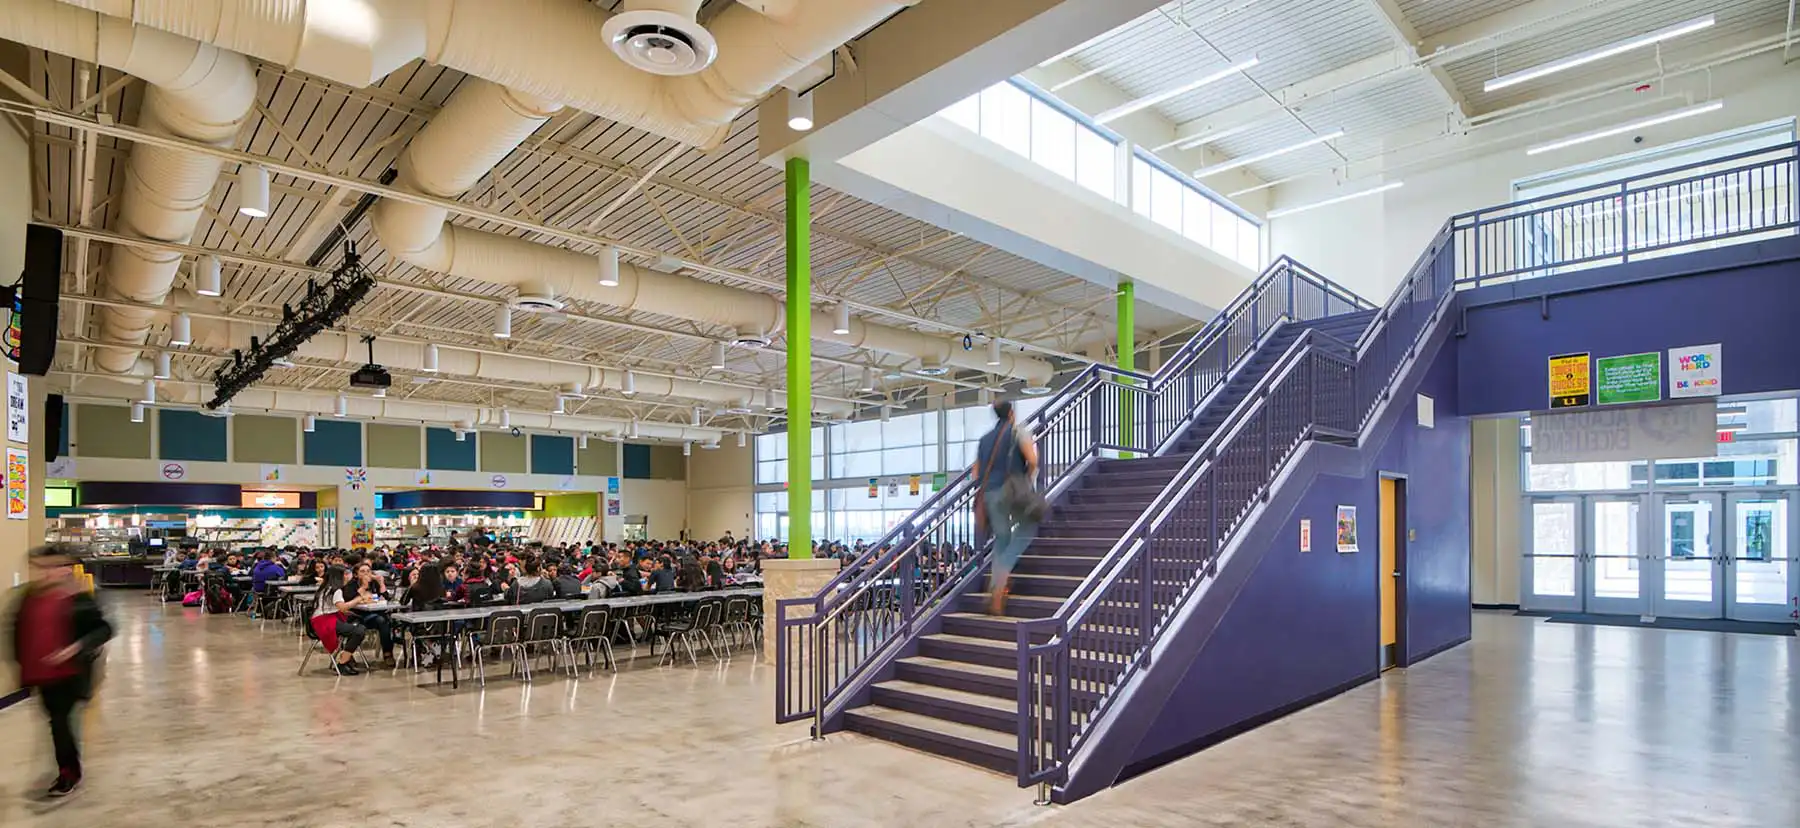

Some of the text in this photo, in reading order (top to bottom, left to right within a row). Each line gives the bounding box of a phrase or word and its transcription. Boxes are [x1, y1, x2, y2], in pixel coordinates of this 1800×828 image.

[1679, 353, 1712, 363] WORK
[1681, 361, 1710, 371] HARD
[1677, 380, 1688, 388] BE
